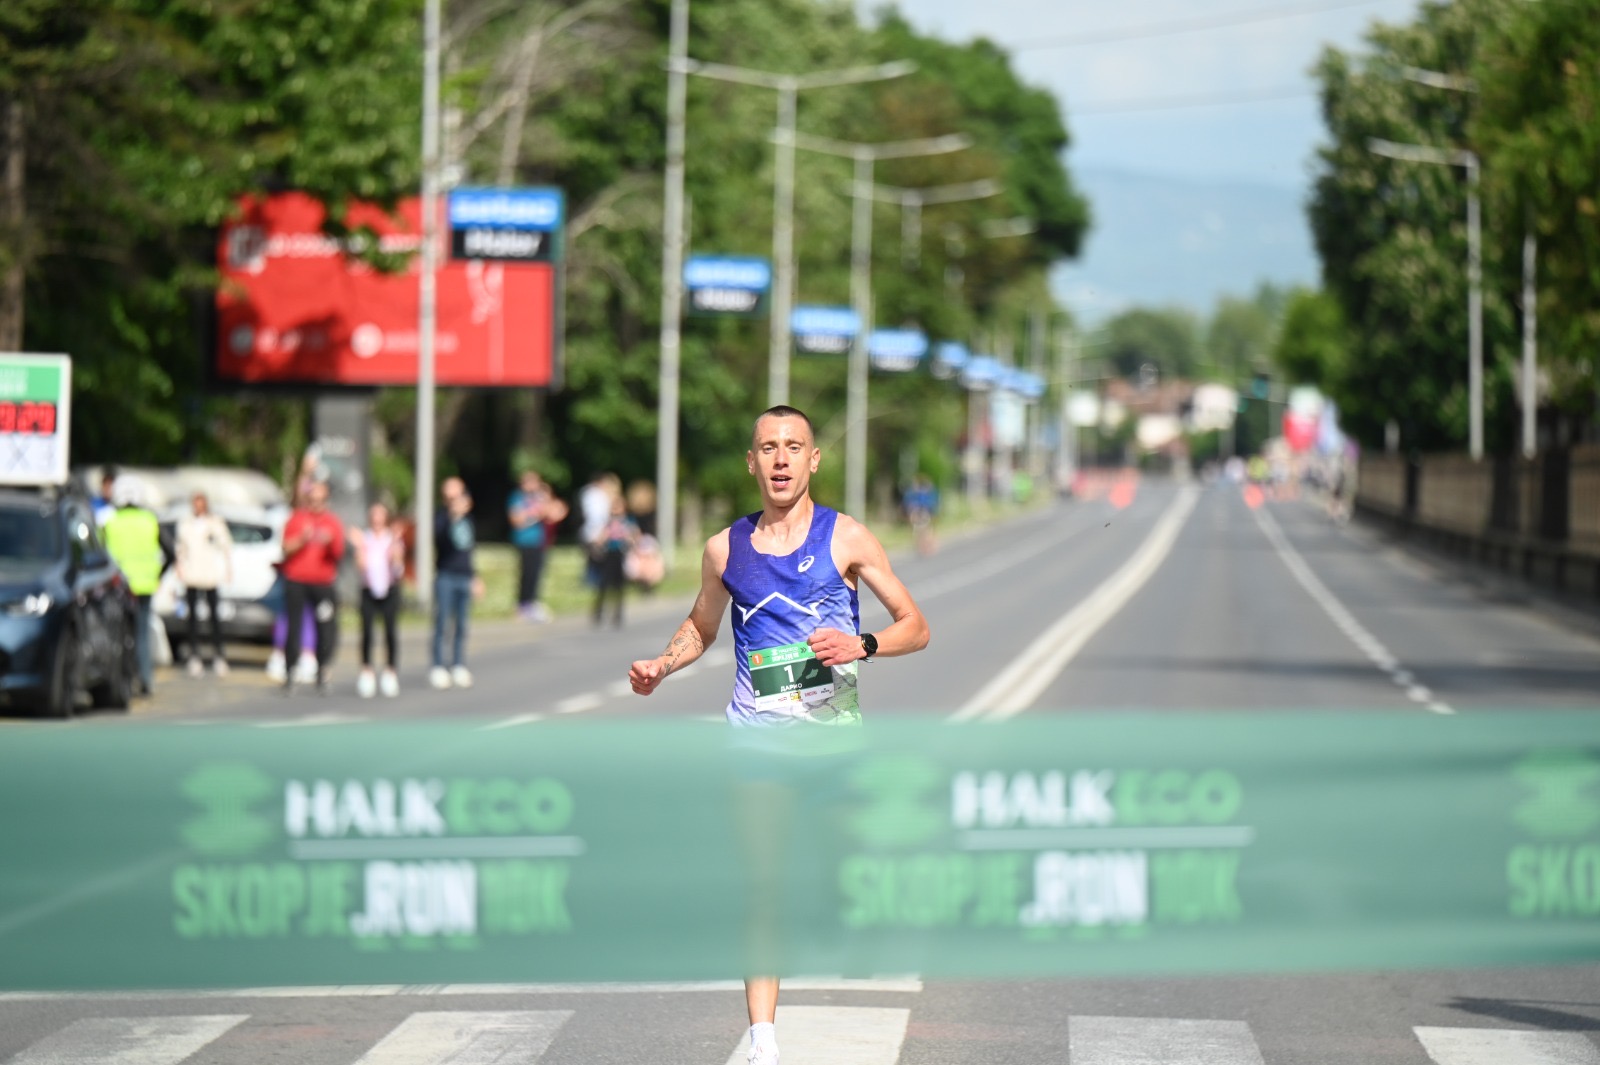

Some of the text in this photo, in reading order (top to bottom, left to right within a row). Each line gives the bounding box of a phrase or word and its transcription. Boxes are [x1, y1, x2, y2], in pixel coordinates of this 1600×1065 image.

[783, 664, 795, 683] 1
[285, 778, 575, 837] HALKECO
[950, 769, 1243, 828] HALKECO
